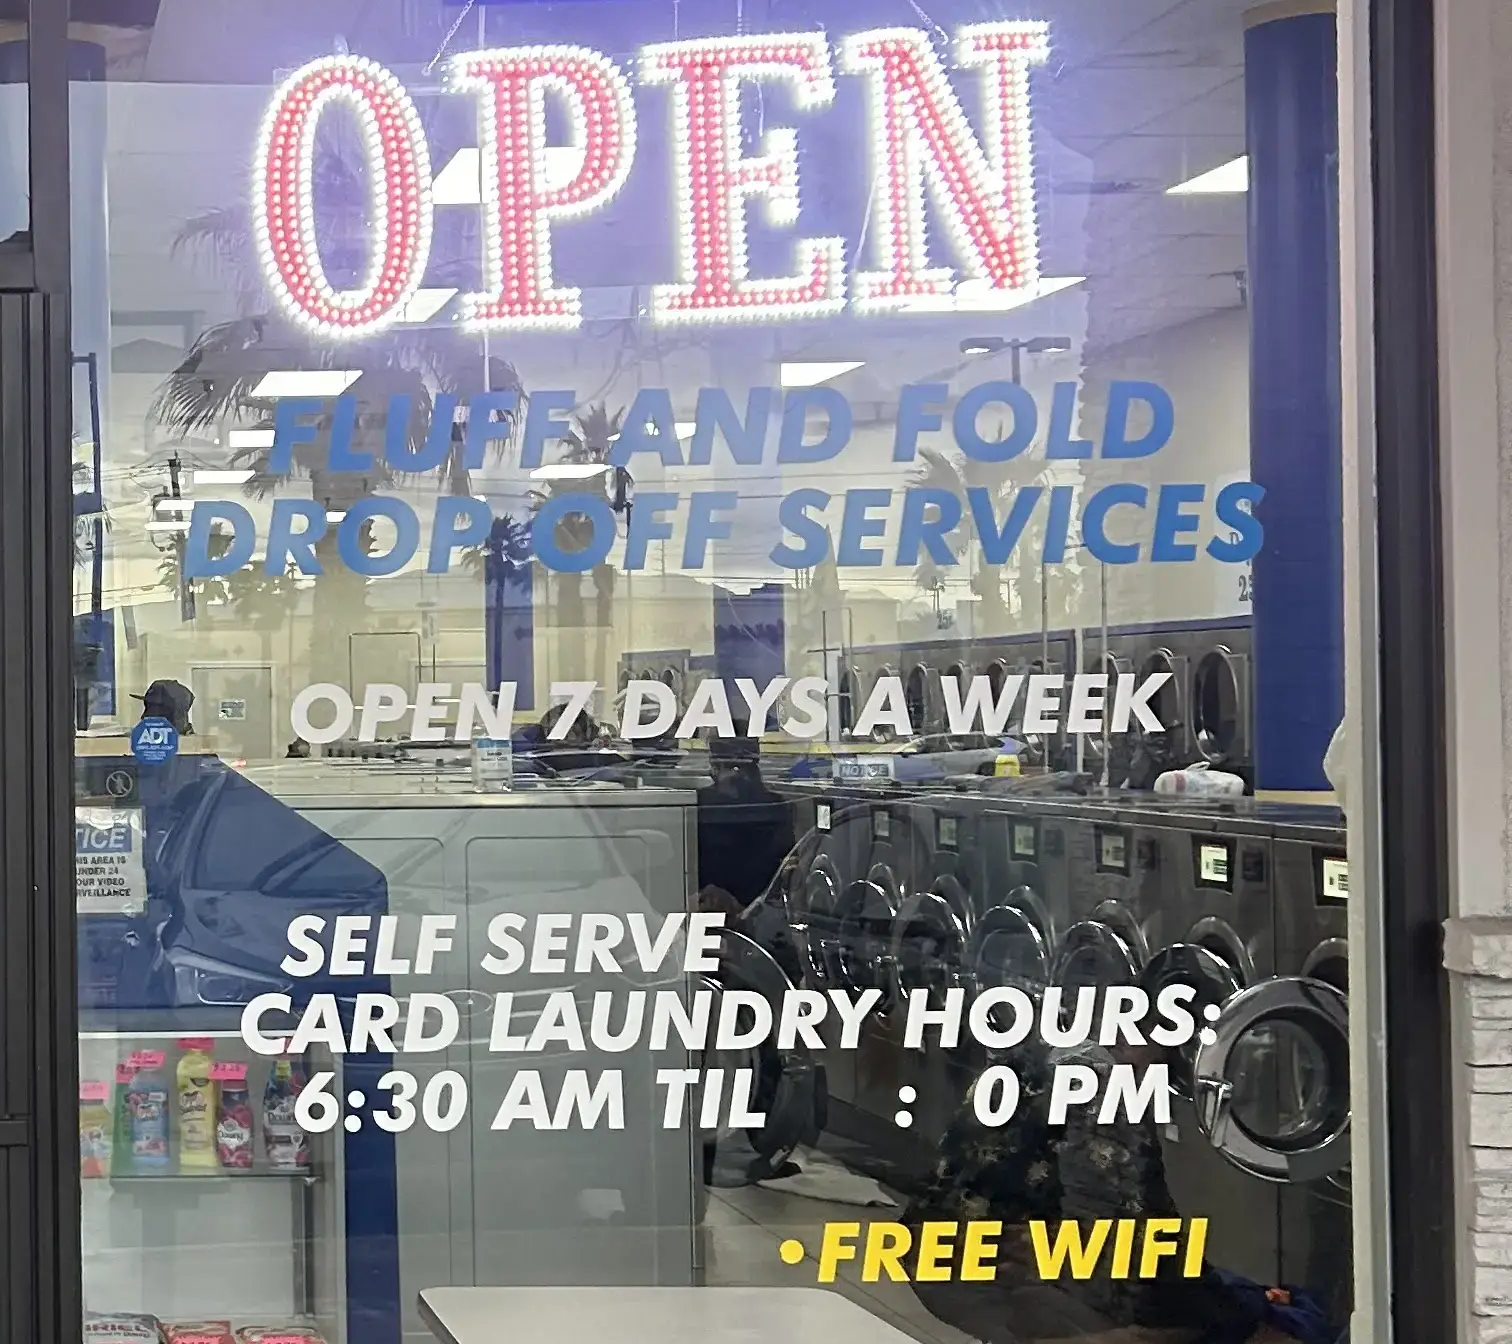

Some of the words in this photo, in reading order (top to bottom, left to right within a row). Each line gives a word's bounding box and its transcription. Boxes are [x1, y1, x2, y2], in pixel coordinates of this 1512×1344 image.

[249, 17, 1054, 342] OPEN
[268, 389, 579, 475] FLUFF
[608, 386, 854, 468] AND
[892, 380, 1176, 463] FOLD
[186, 494, 493, 579] DROP
[531, 490, 739, 574] OFF
[768, 482, 1267, 571] SERVICES
[137, 728, 173, 745] ADT
[290, 681, 516, 746] OPEN
[547, 681, 599, 741] 7
[620, 676, 831, 740] DAYS
[852, 675, 914, 738] A
[940, 672, 1175, 737] WEEK
[841, 764, 888, 777] NOTCE
[90, 856, 115, 865] AREA
[97, 878, 126, 886] VIDEO
[279, 914, 458, 977] SELF
[480, 911, 728, 975] SERVE
[239, 992, 461, 1055] CARD
[488, 988, 884, 1052] LAUNDRY
[903, 984, 1223, 1050] HOURS:
[292, 1069, 470, 1134] 6:30
[490, 1068, 626, 1131] AM
[656, 1068, 768, 1130] TIL
[1047, 1063, 1173, 1127] PM
[816, 1221, 1001, 1283] FREE
[1028, 1217, 1209, 1281] WIFI
